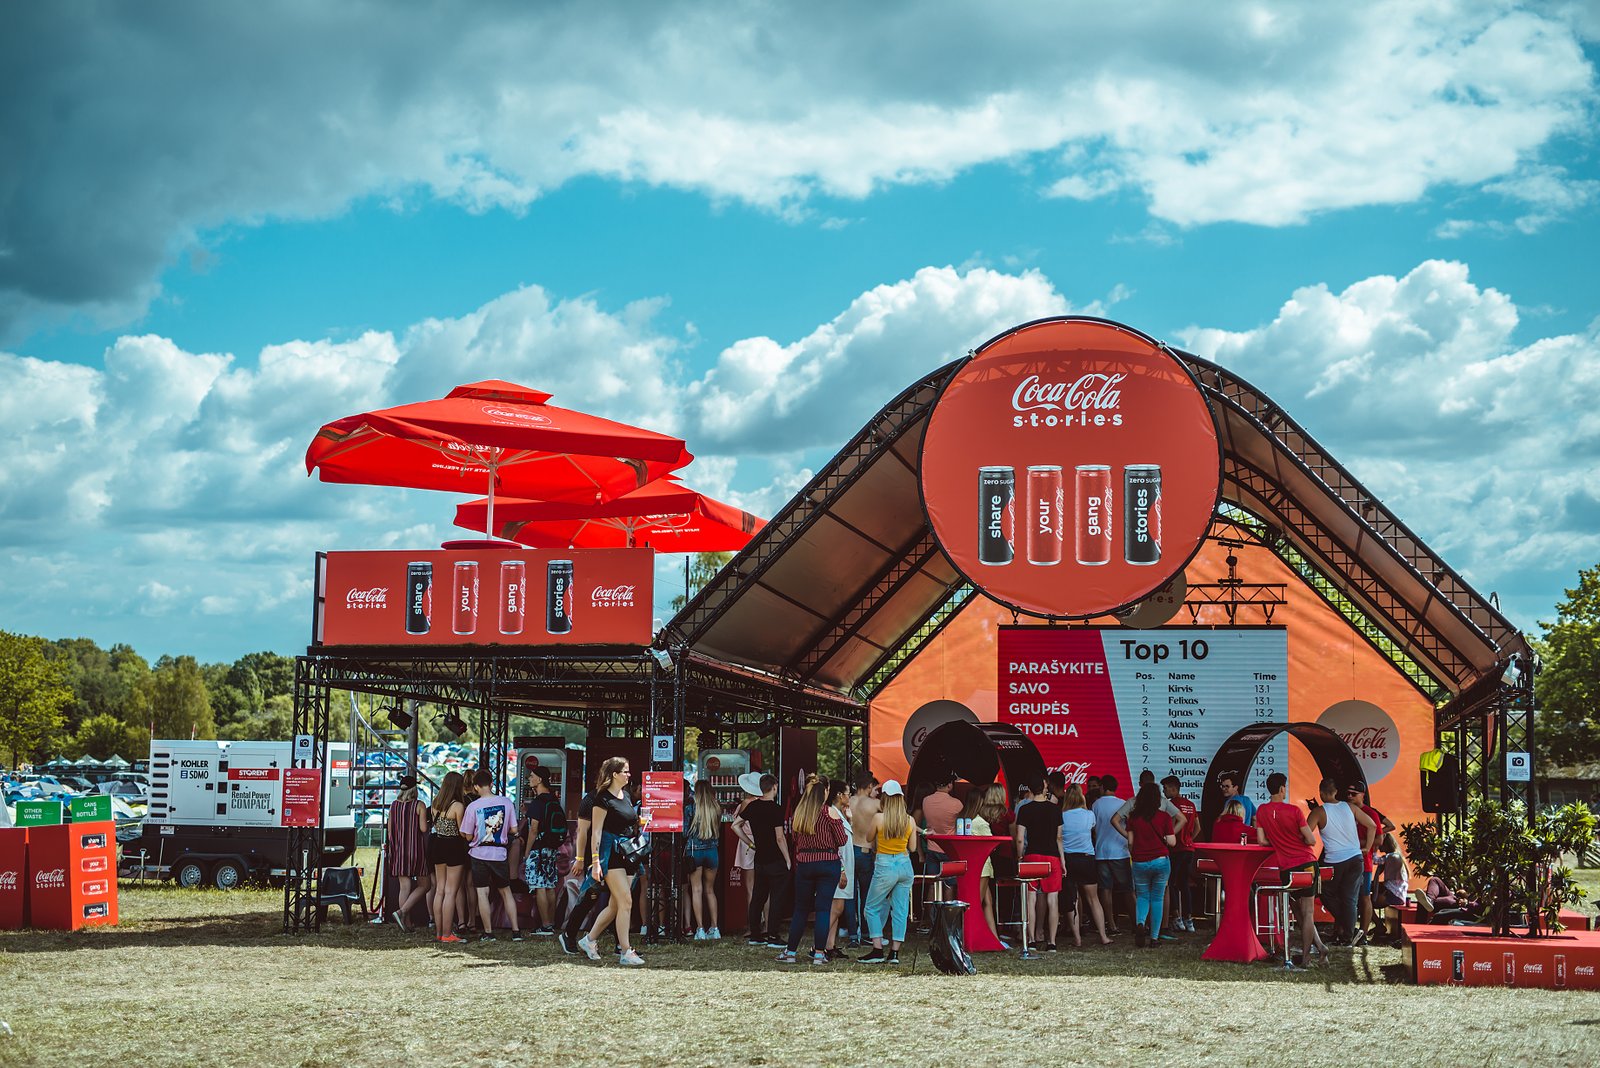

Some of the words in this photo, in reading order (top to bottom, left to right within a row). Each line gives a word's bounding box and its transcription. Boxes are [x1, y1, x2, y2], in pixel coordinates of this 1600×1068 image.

[1012, 373, 1128, 412] Coca-Cola
[988, 495, 1001, 538] share
[1040, 499, 1052, 534] your
[1088, 497, 1101, 536] gang
[1134, 489, 1148, 542] stories
[346, 588, 389, 602] Coca-Cola
[413, 582, 423, 615] share
[461, 586, 470, 612] your
[508, 584, 517, 612] gang
[554, 578, 564, 617] stories
[591, 585, 636, 600] Coca-Cola
[1120, 640, 1169, 664] Top
[1179, 640, 1209, 660] 10
[1009, 660, 1104, 674] PARAŠYKITE
[1009, 682, 1050, 694] SAVO
[1168, 684, 1193, 692] Kirvis
[1255, 685, 1270, 693] 13.1
[1009, 700, 1070, 714] GRUPĖS
[1168, 696, 1198, 705] Felixas
[1255, 709, 1273, 717] 13.2
[180, 760, 208, 768] KOHLER
[1168, 756, 1207, 764] Simonas
[1256, 756, 1274, 764] 13.9
[189, 771, 208, 779] SDMO
[231, 799, 270, 809] COMPACT
[36, 869, 65, 884] Coca-Cola
